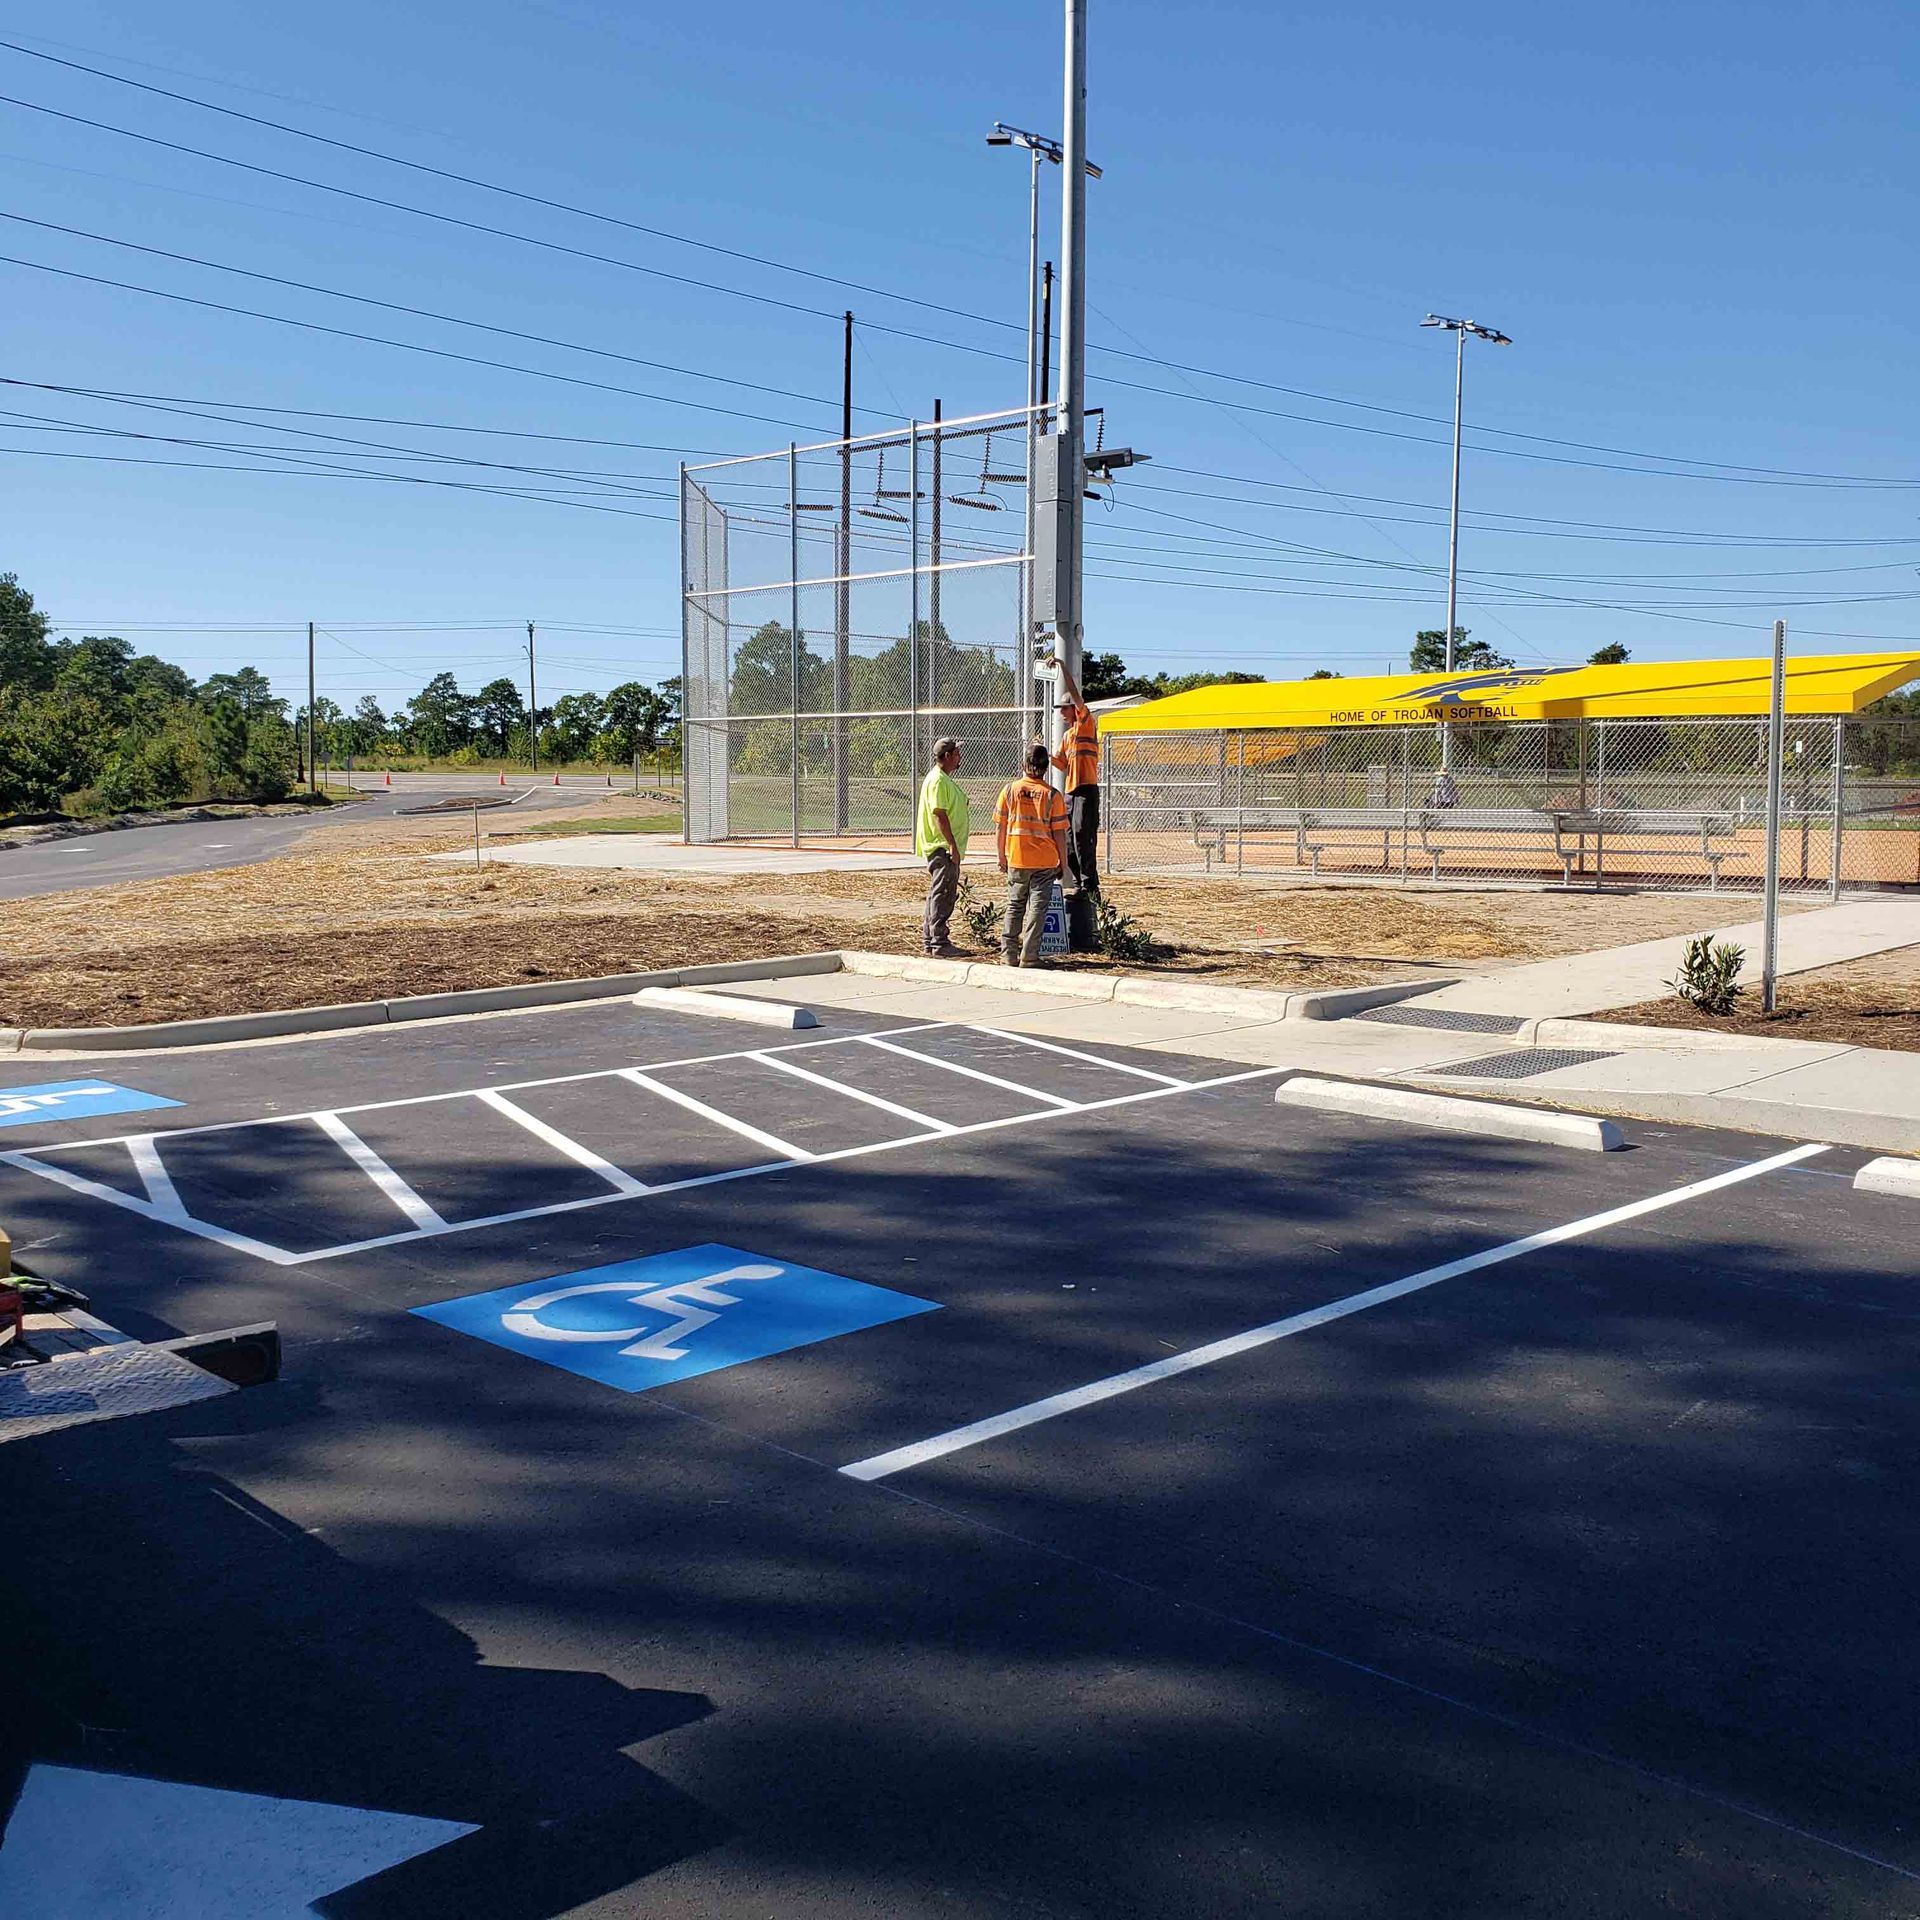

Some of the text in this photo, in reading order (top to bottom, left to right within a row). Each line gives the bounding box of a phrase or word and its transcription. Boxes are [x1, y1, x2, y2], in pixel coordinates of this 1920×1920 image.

[1330, 705, 1518, 723] HOME OF TROJAN SOFTBALL
[1040, 936, 1065, 944] PARKIN
[1041, 945, 1067, 953] RESERVE
